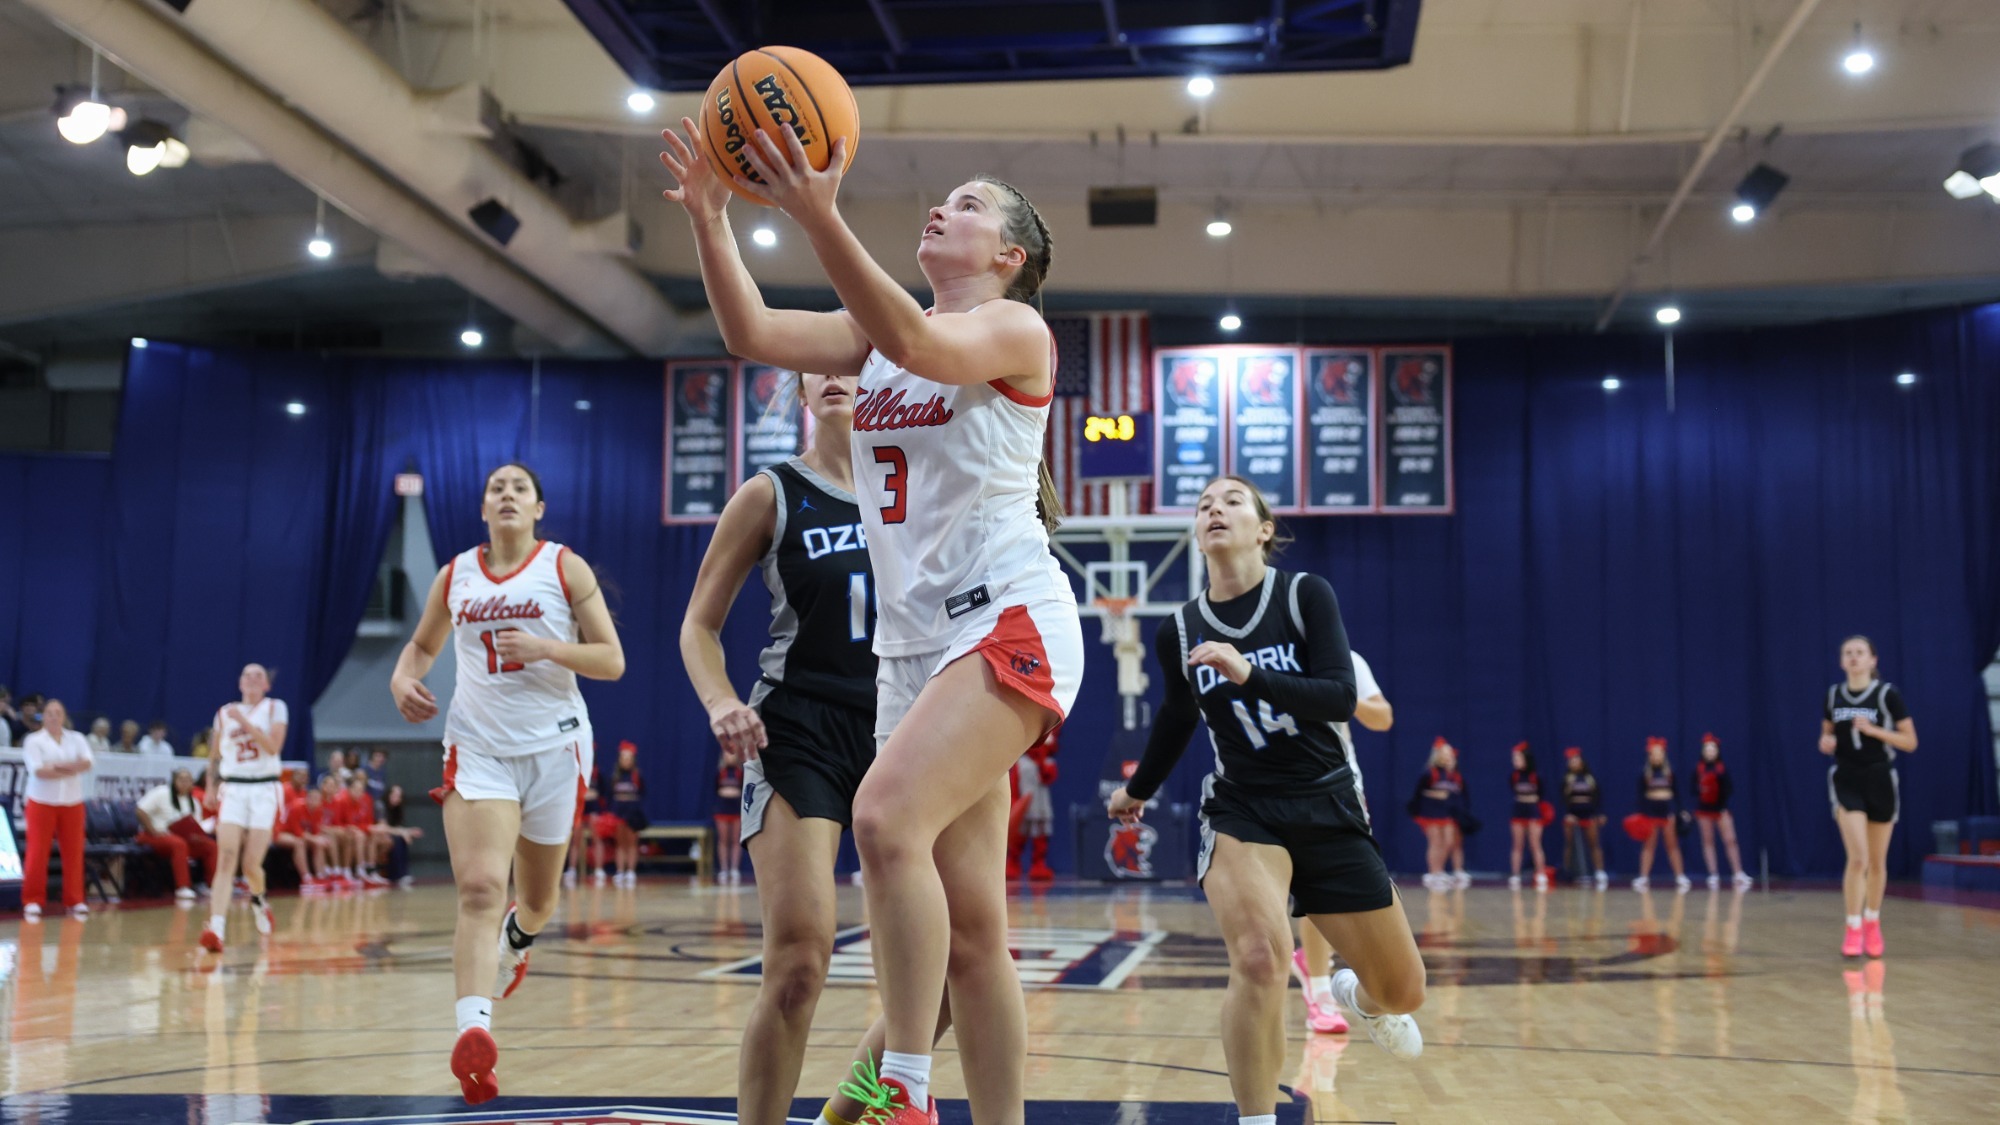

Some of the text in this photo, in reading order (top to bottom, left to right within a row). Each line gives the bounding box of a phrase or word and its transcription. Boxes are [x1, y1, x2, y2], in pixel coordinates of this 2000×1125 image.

[872, 445, 908, 525] 3
[456, 594, 544, 626] Hillcats
[973, 591, 983, 601] M
[1230, 699, 1299, 750] 14
[235, 739, 259, 763] 25
